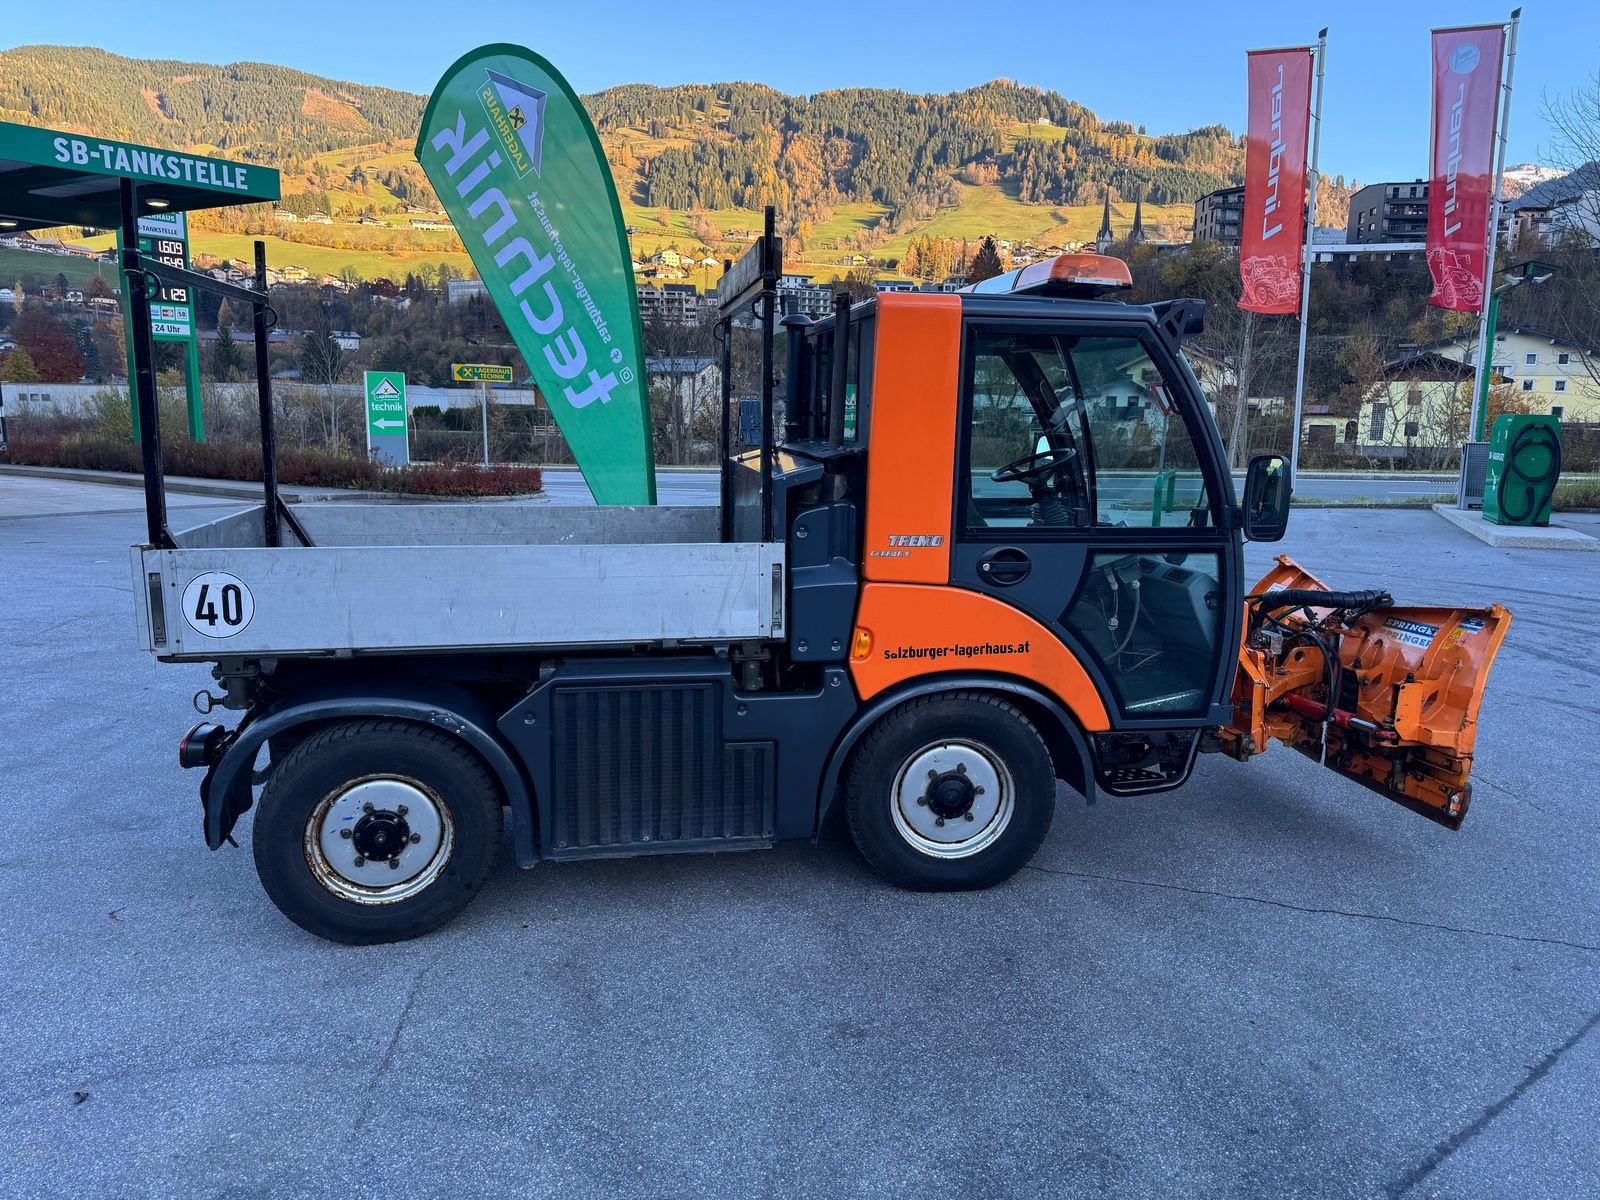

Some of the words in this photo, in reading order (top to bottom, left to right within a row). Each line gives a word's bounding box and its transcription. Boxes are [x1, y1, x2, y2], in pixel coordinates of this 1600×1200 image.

[53, 137, 248, 190] SB-TANKSTELLE
[154, 323, 165, 332] 24
[167, 325, 181, 333] Uhr
[474, 367, 510, 375] LAGERHAUS
[371, 401, 403, 411] technik
[888, 535, 944, 547] TREMO
[195, 583, 243, 627] 40
[884, 640, 1030, 660] salzburger-lagerhaus.at
